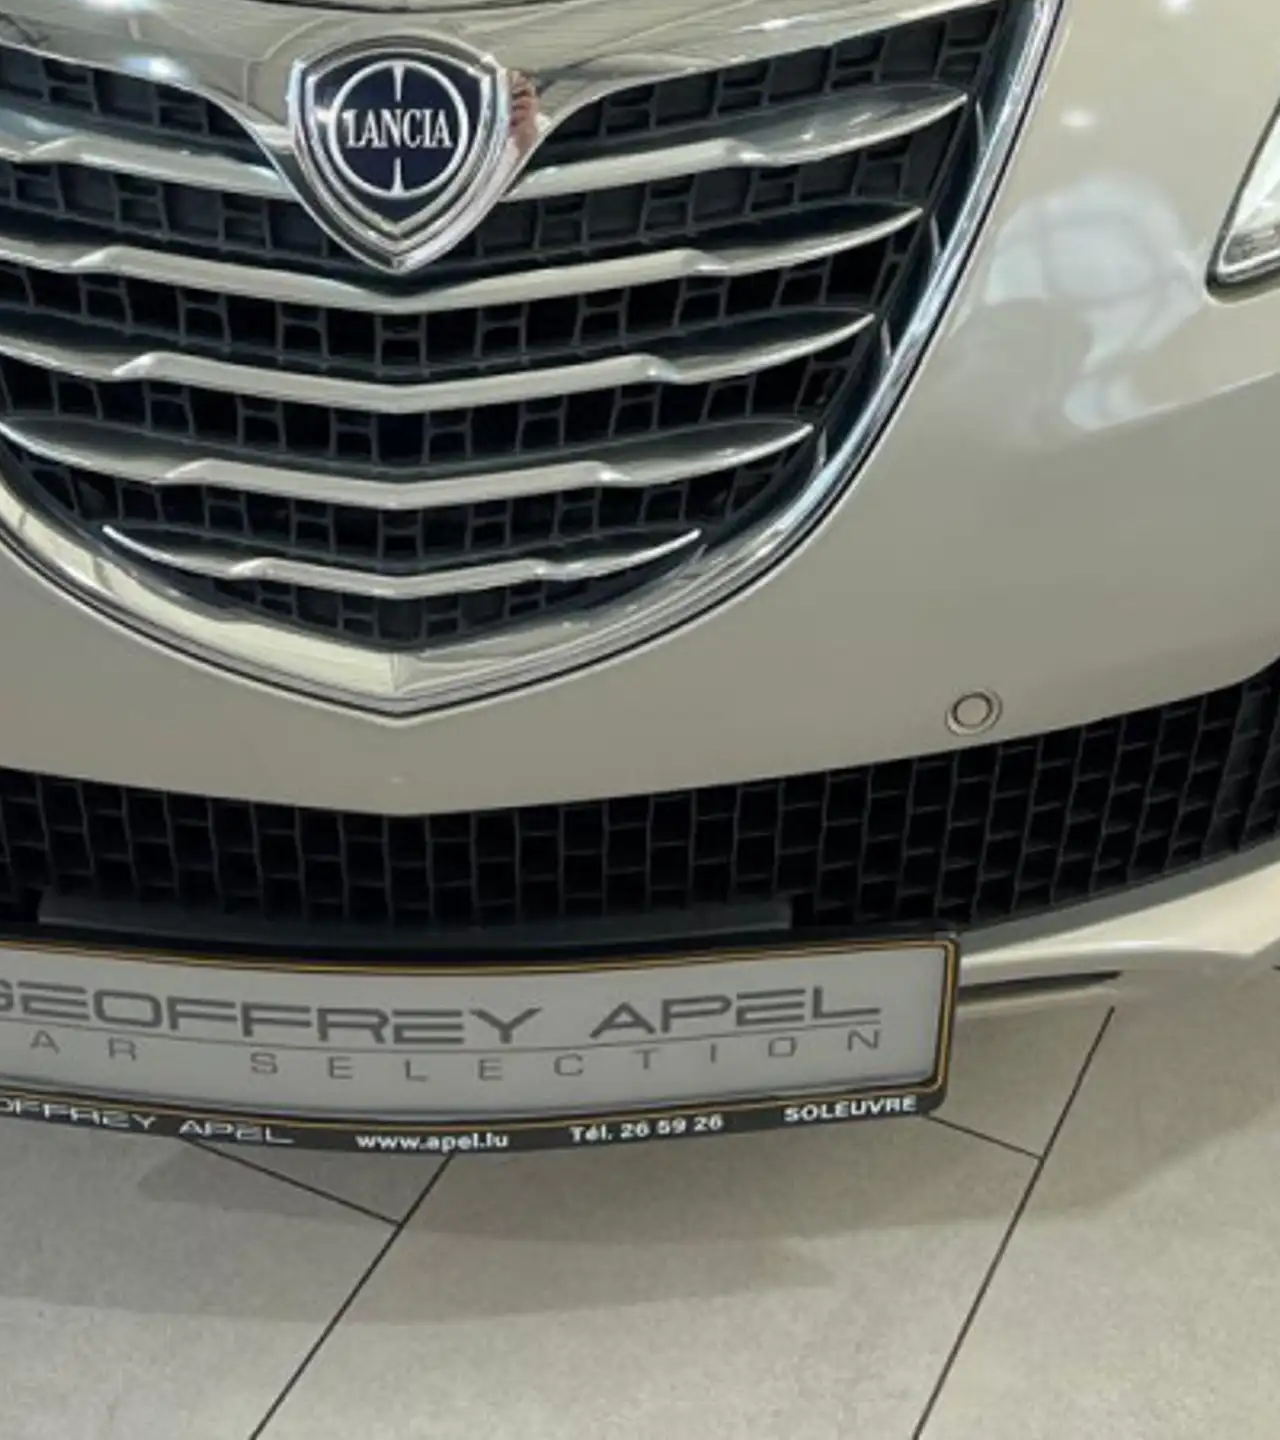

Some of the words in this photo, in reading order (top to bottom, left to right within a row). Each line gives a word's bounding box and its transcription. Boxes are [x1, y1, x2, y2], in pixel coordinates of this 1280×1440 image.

[343, 109, 453, 148] LANCIA
[590, 986, 881, 1038] APEL
[250, 1029, 880, 1082] SELECTION
[179, 1118, 294, 1145] APEL
[355, 1132, 510, 1153] www.apel.lu
[570, 1124, 613, 1143] Tél.
[620, 1121, 650, 1139] 26
[658, 1117, 686, 1135] 59
[693, 1114, 724, 1132] 26
[783, 1095, 917, 1122] SOLEUVRE
